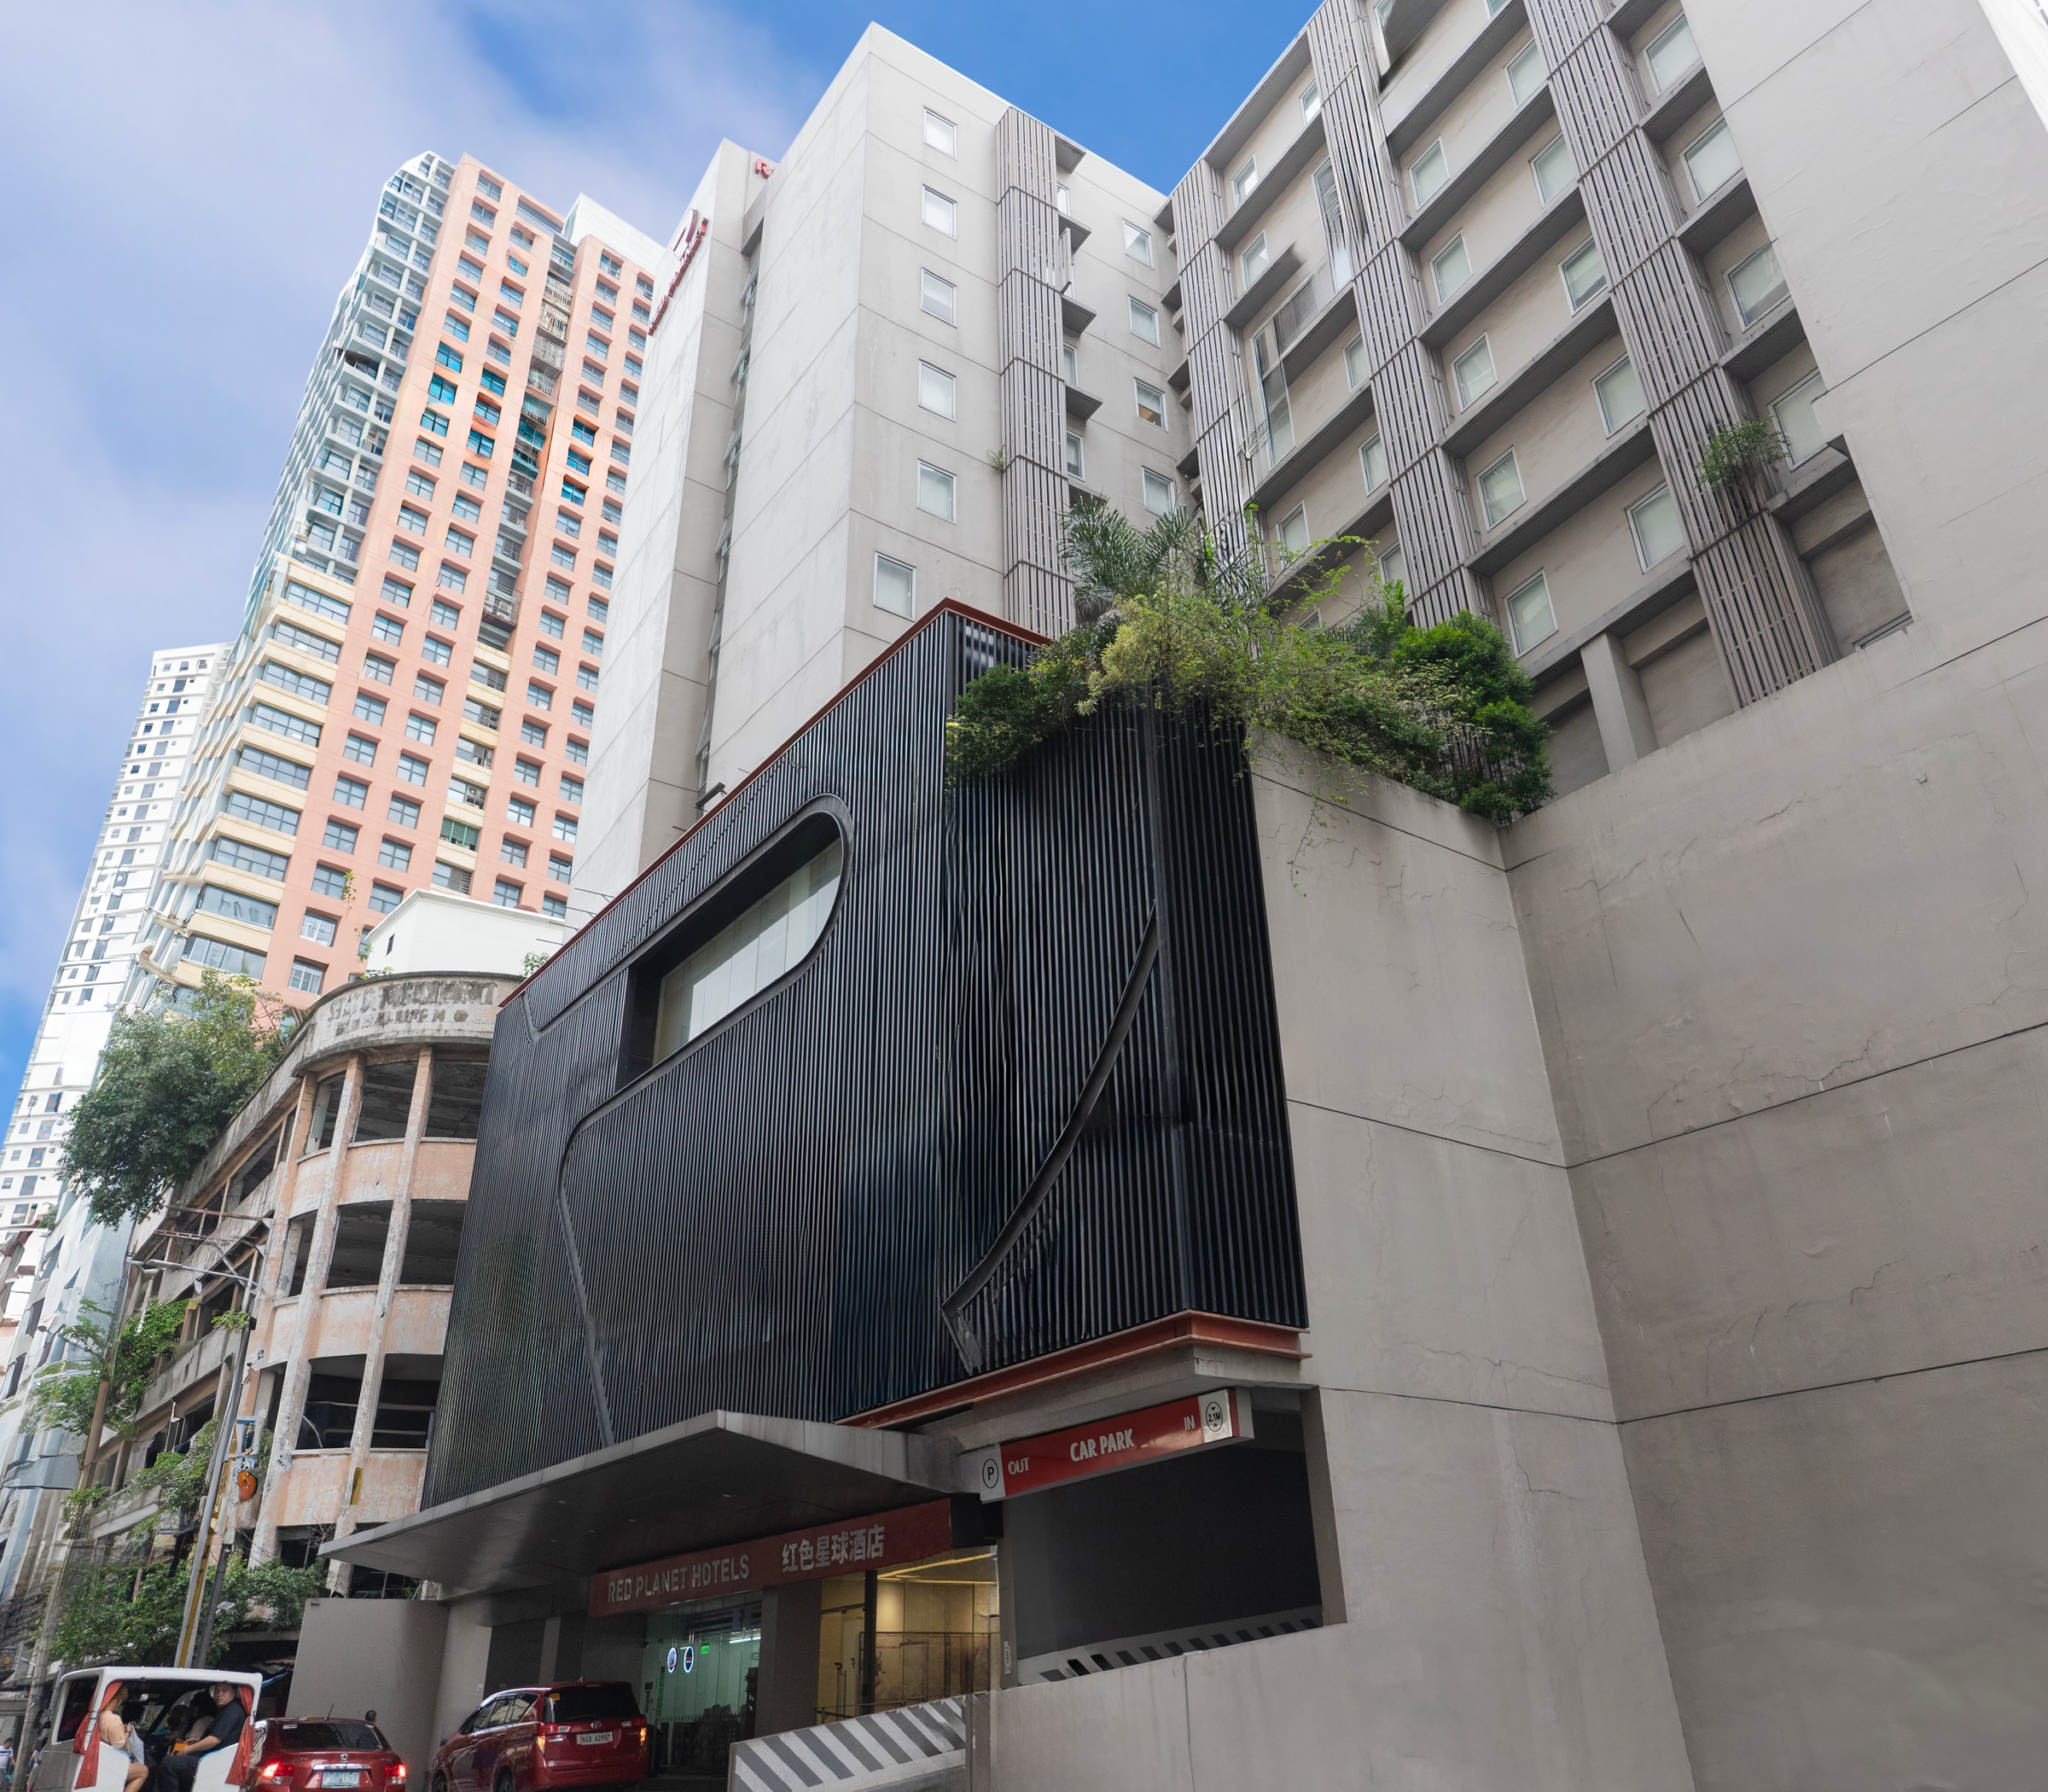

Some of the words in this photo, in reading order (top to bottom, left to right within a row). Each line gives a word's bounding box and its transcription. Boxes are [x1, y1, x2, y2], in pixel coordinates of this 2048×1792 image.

[1183, 1415, 1195, 1431] IN
[1207, 1411, 1221, 1423] 2.1M
[1070, 1438, 1097, 1462] CAR
[1099, 1428, 1135, 1454] PARK
[987, 1466, 995, 1481] P
[1008, 1457, 1030, 1475] OUT
[782, 1524, 885, 1573] 红色星球酒店
[608, 1578, 632, 1603] RED
[636, 1567, 689, 1598] PLANET
[692, 1554, 750, 1587] HOTELS
[595, 1734, 608, 1743] 6295
